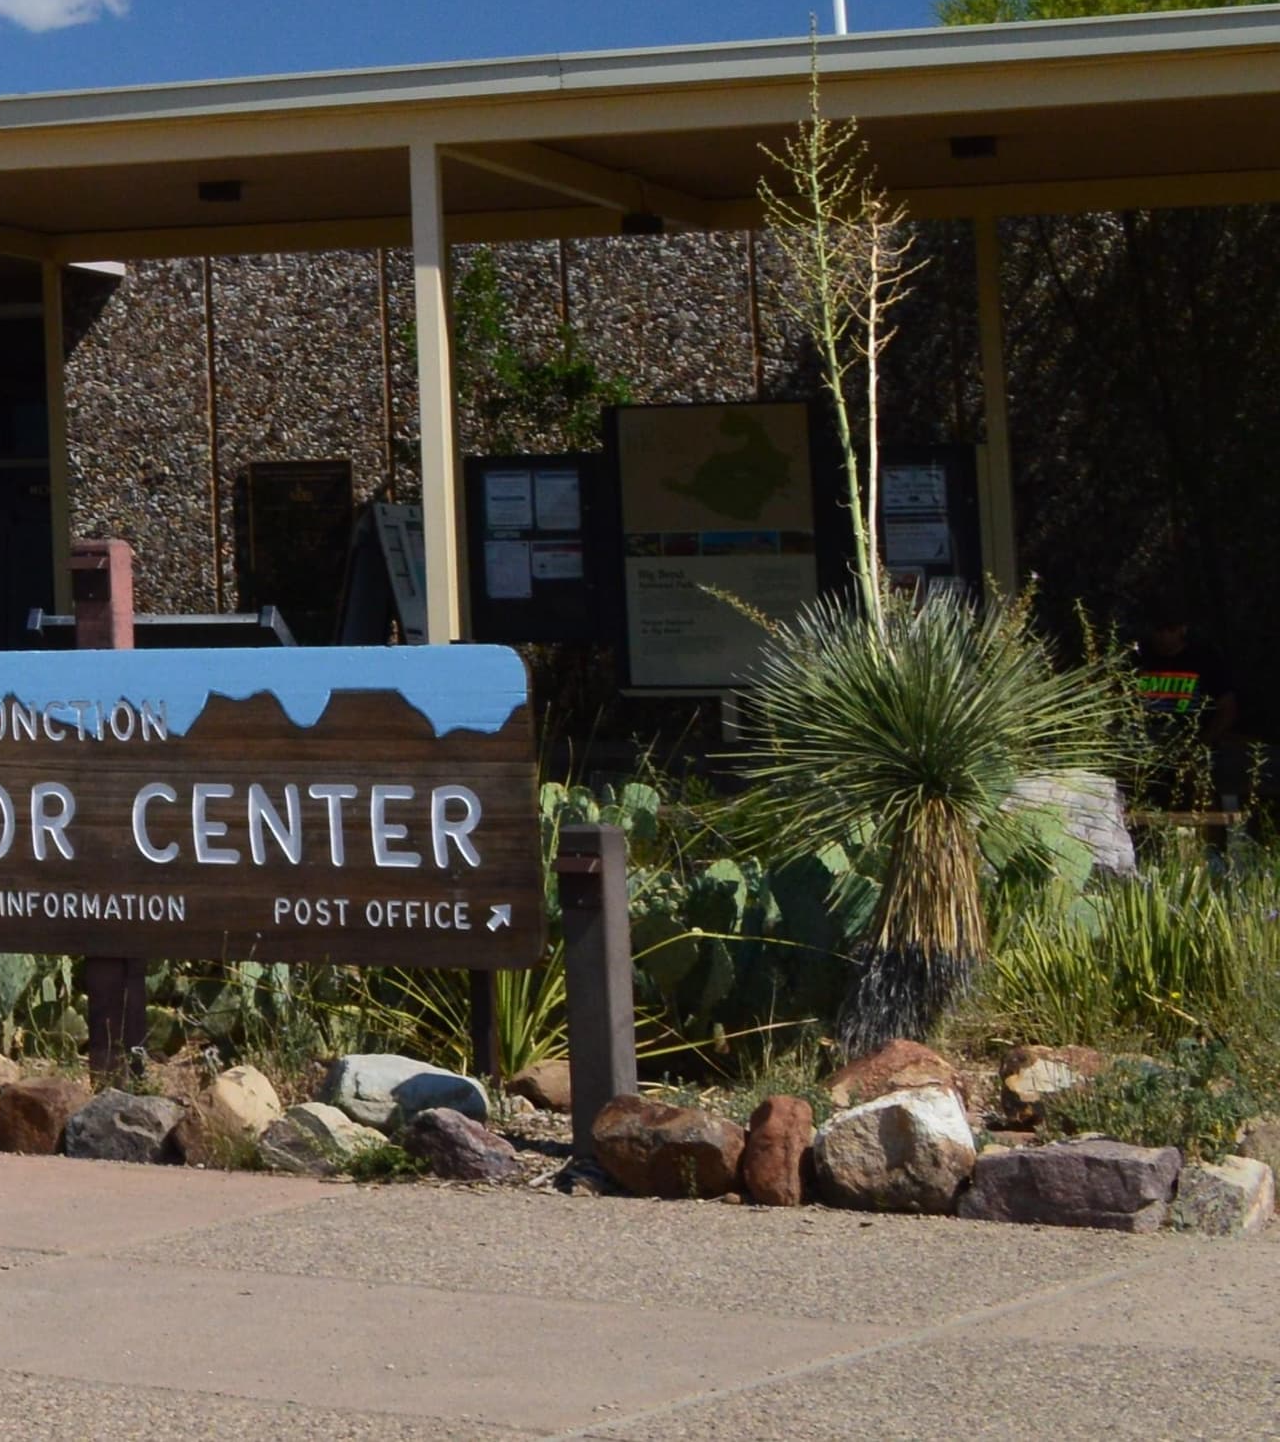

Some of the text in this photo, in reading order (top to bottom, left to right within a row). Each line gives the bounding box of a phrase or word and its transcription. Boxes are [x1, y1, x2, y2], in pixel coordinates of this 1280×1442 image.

[132, 781, 482, 869] CENTER
[0, 890, 186, 922] INFORMATION
[274, 897, 472, 931] POST OFFICE
